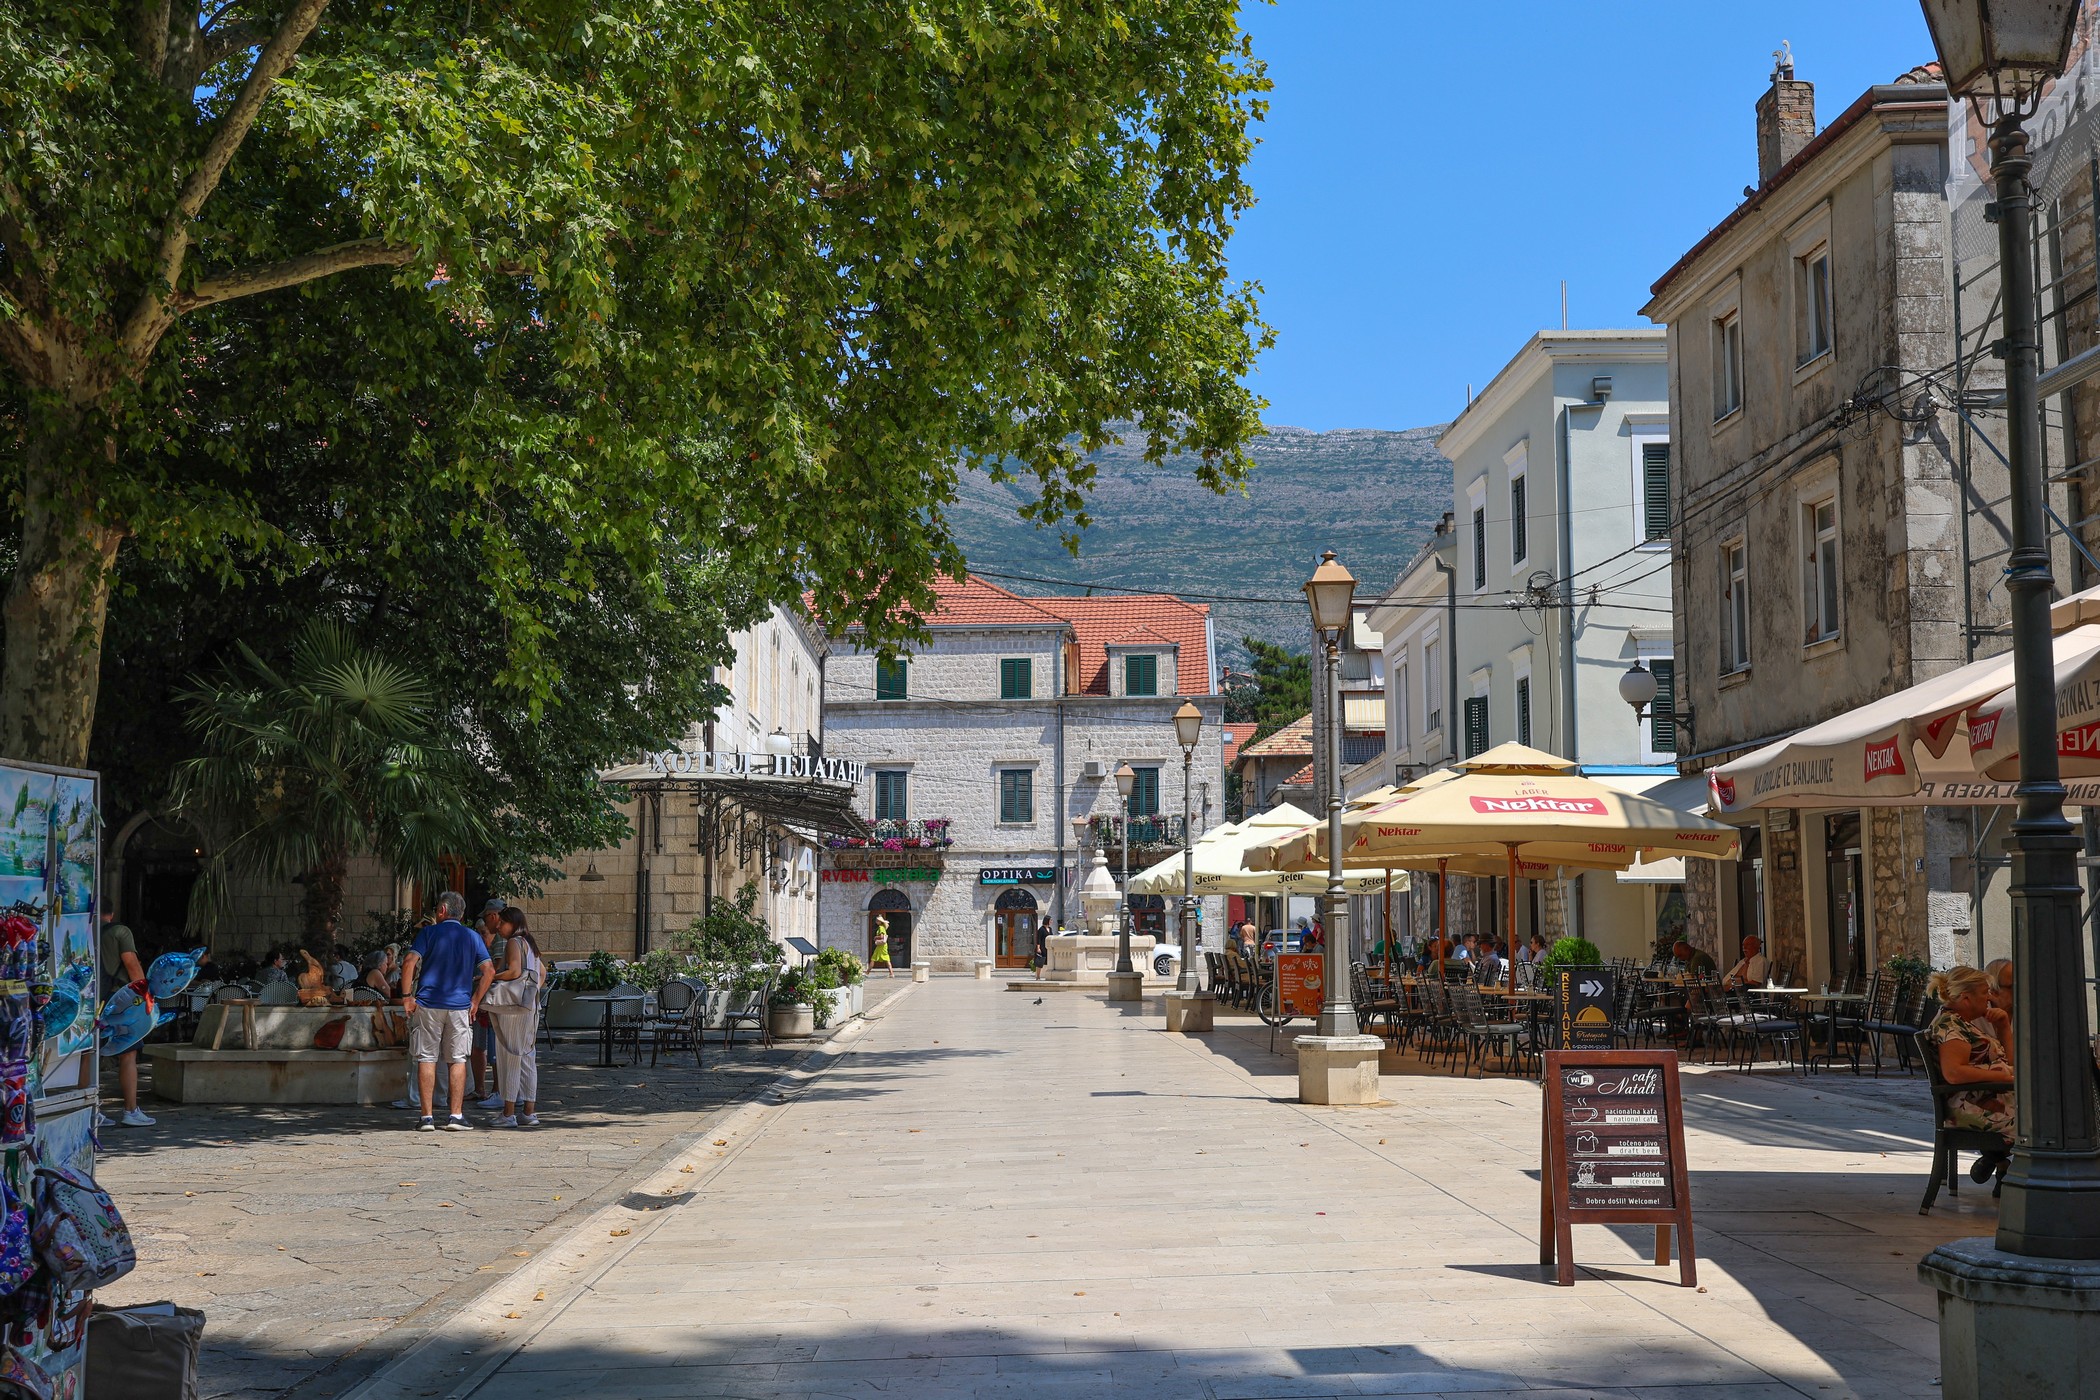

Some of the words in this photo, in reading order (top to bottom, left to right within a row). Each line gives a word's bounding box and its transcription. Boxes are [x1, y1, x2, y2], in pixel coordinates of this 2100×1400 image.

[1866, 747, 1896, 774] NEKTAR
[650, 751, 751, 774] ХОТЕЛ
[773, 753, 865, 785] ПЛАТАНИ
[1752, 765, 1783, 796] NAJBOLJE
[1783, 763, 1791, 787] IZ
[1792, 758, 1834, 786] BANJALUKE
[1515, 788, 1549, 796] LAGER
[1480, 798, 1594, 812] Nektar
[1377, 827, 1422, 837] Nektar
[1674, 832, 1720, 842] Nektar
[873, 865, 940, 886] apoteka
[982, 869, 1033, 879] OPTIKA
[1195, 874, 1222, 885] Jelen
[1277, 872, 1304, 884] Jelen
[1359, 876, 1386, 888] Jelen
[1632, 1068, 1658, 1086] cafe
[1597, 1077, 1656, 1095] Natali
[1585, 1197, 1605, 1205] Dobro
[1628, 1197, 1660, 1205] Welcome!
